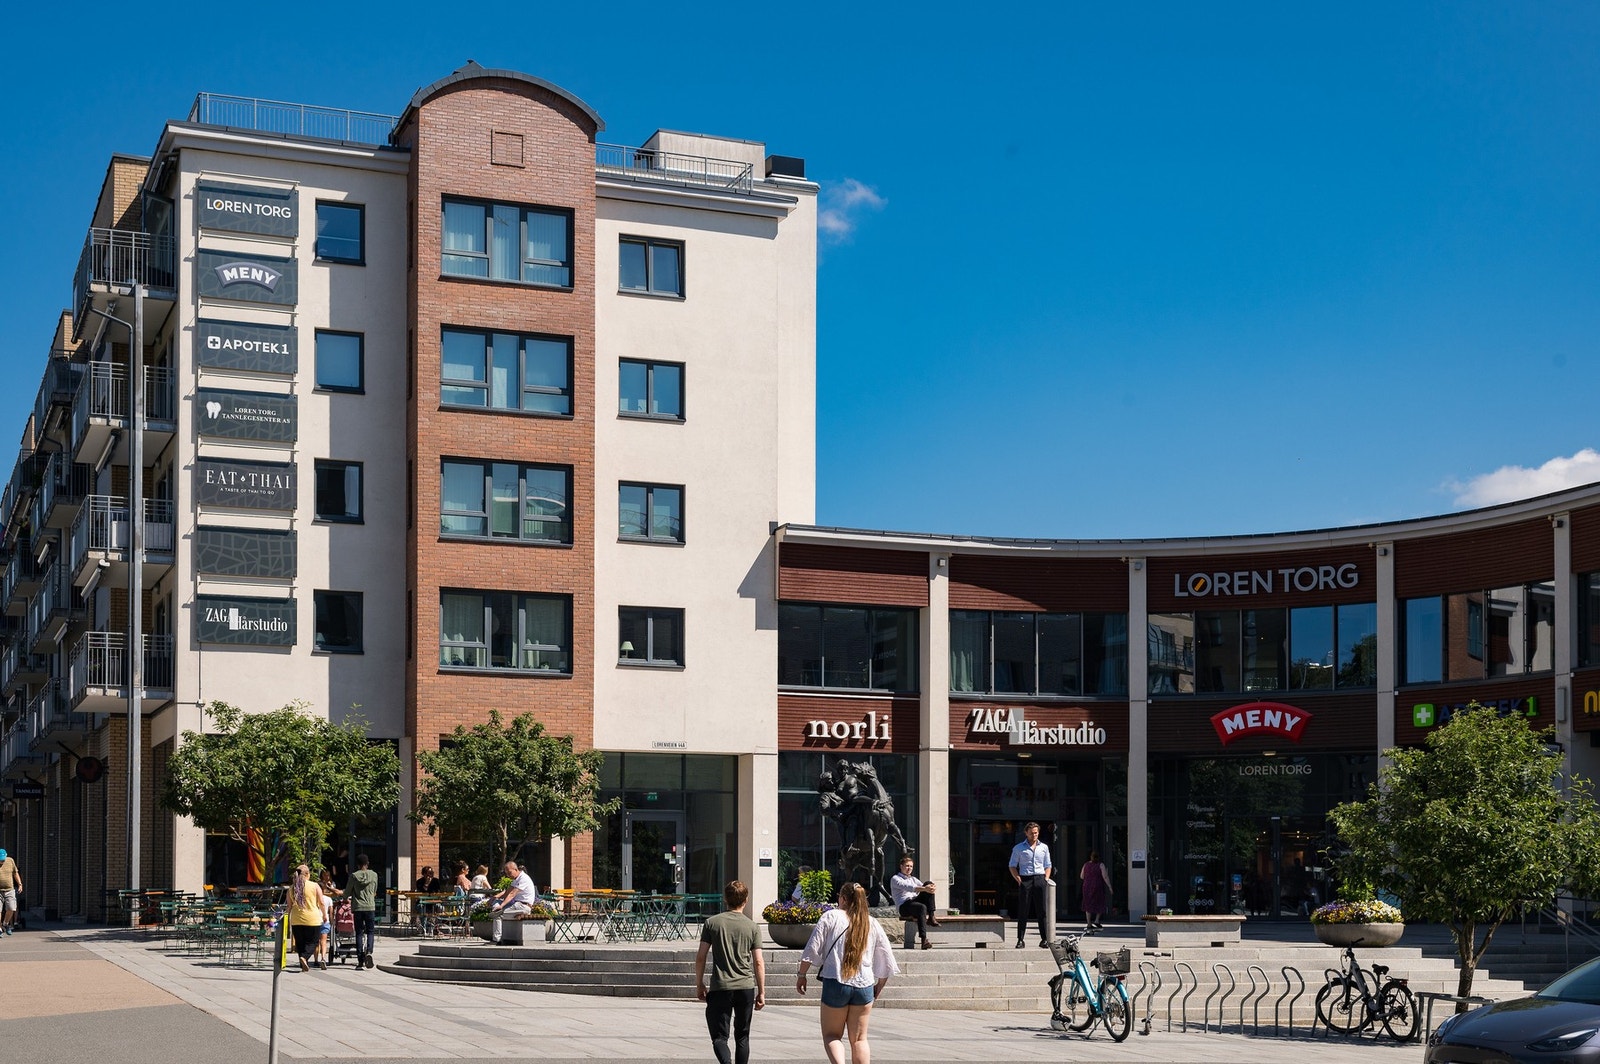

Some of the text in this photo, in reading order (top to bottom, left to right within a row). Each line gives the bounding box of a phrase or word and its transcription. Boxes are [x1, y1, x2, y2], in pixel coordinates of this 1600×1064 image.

[207, 198, 291, 219] LØREN TORG
[223, 267, 276, 284] MENY
[222, 338, 289, 355] APOTEK 1
[222, 413, 281, 423] TANNLEGESENTER
[206, 470, 290, 489] EAT THAI
[1174, 562, 1359, 597] LØREN TORG
[206, 607, 236, 623] ZAG
[1437, 695, 1537, 722] AEK 1
[808, 711, 893, 741] norli
[971, 708, 1107, 746] ZAGA Hårstudio
[1221, 709, 1302, 736] MENY
[1279, 764, 1312, 775] TORG
